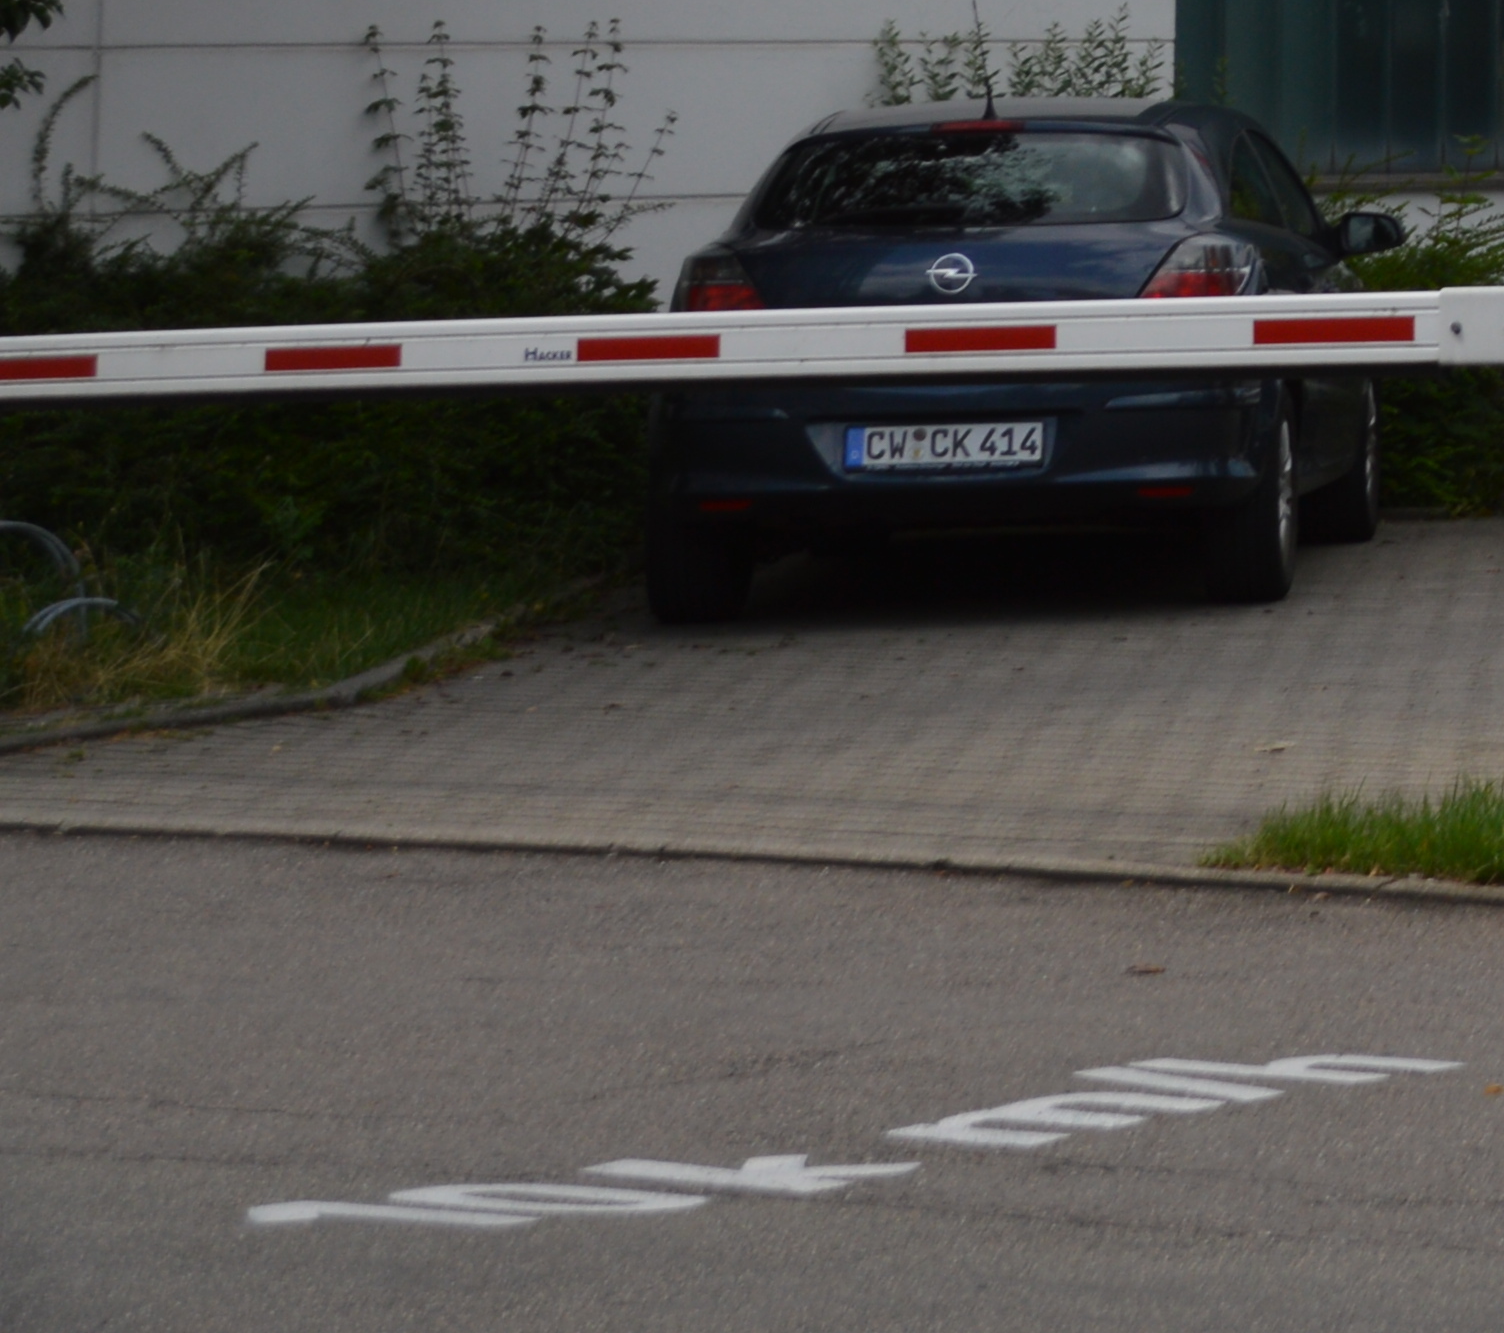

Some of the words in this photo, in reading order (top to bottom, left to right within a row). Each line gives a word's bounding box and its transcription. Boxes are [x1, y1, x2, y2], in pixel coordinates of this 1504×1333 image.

[866, 429, 908, 460] CW
[930, 427, 973, 457] CK
[979, 426, 1039, 456] 414
